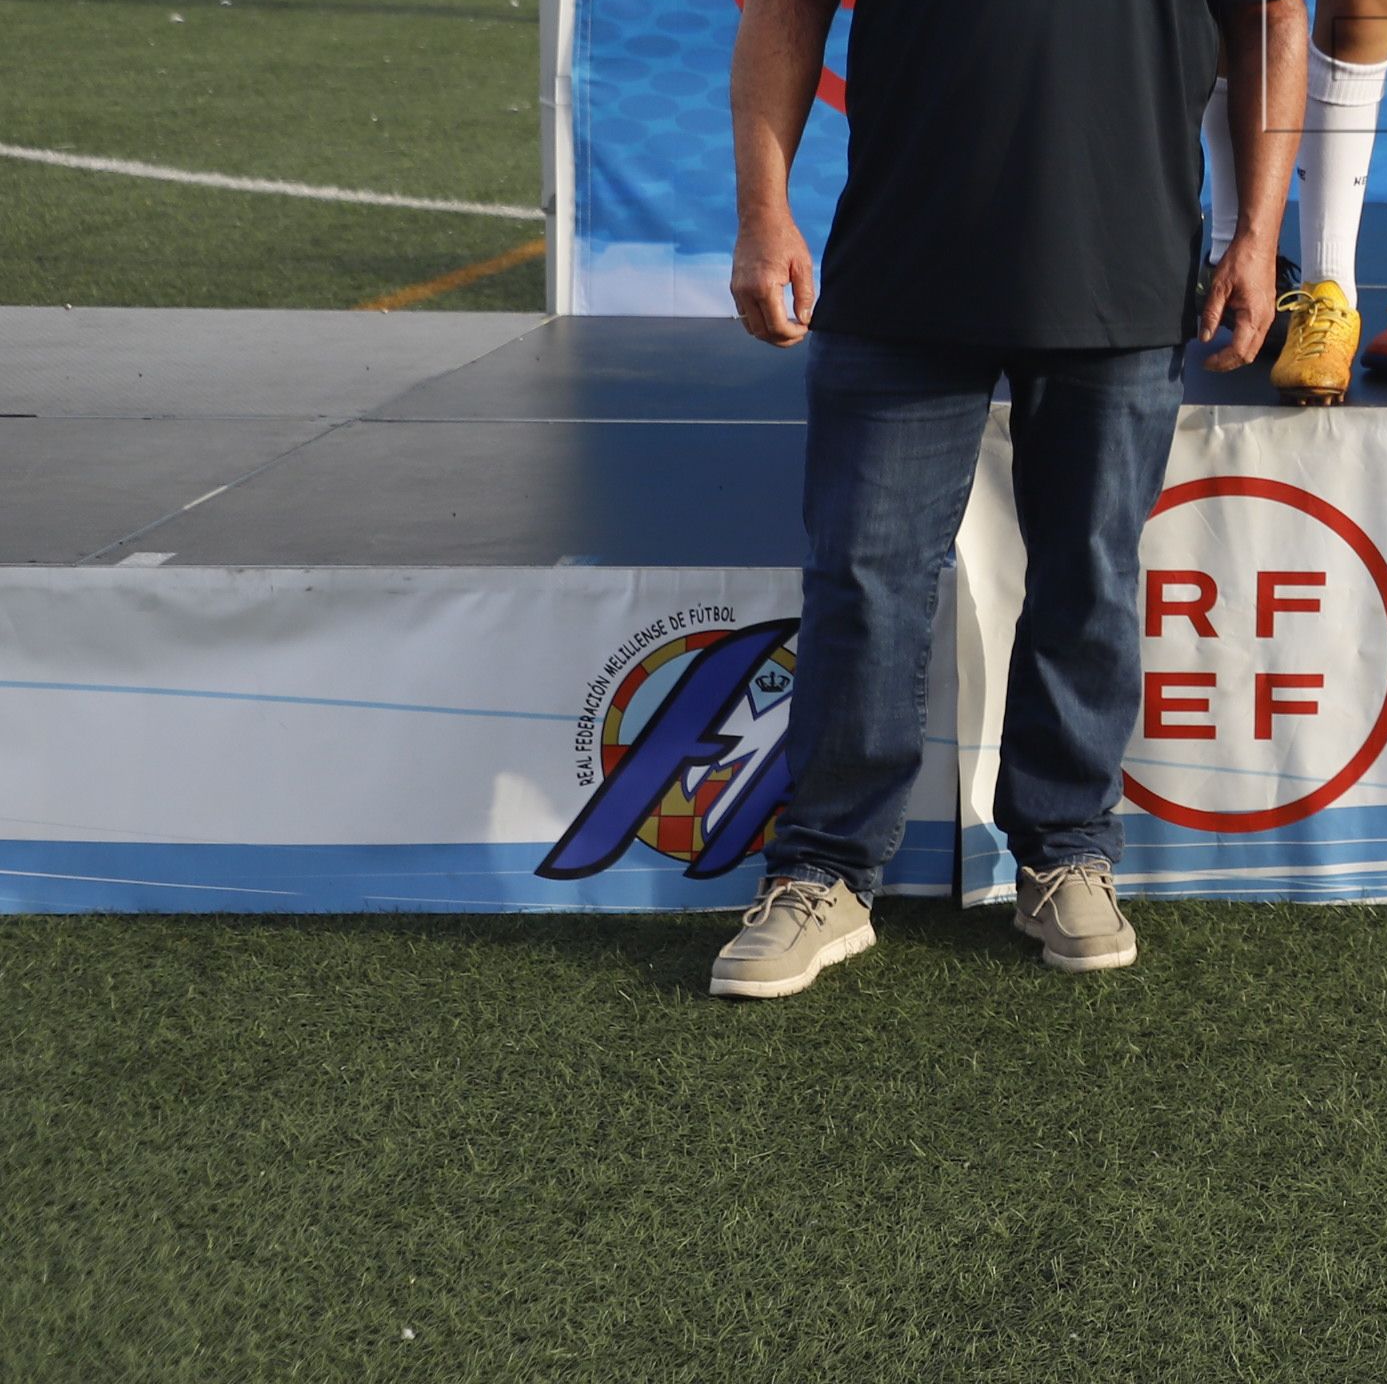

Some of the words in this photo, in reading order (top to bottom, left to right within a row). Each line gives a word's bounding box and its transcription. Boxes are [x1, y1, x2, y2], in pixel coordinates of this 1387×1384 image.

[668, 611, 687, 631] DE
[689, 602, 737, 626] FÚTBOL
[603, 618, 669, 678] MELILLENSE
[574, 673, 612, 752] FEDERACIÓN
[576, 755, 596, 787] REAL
